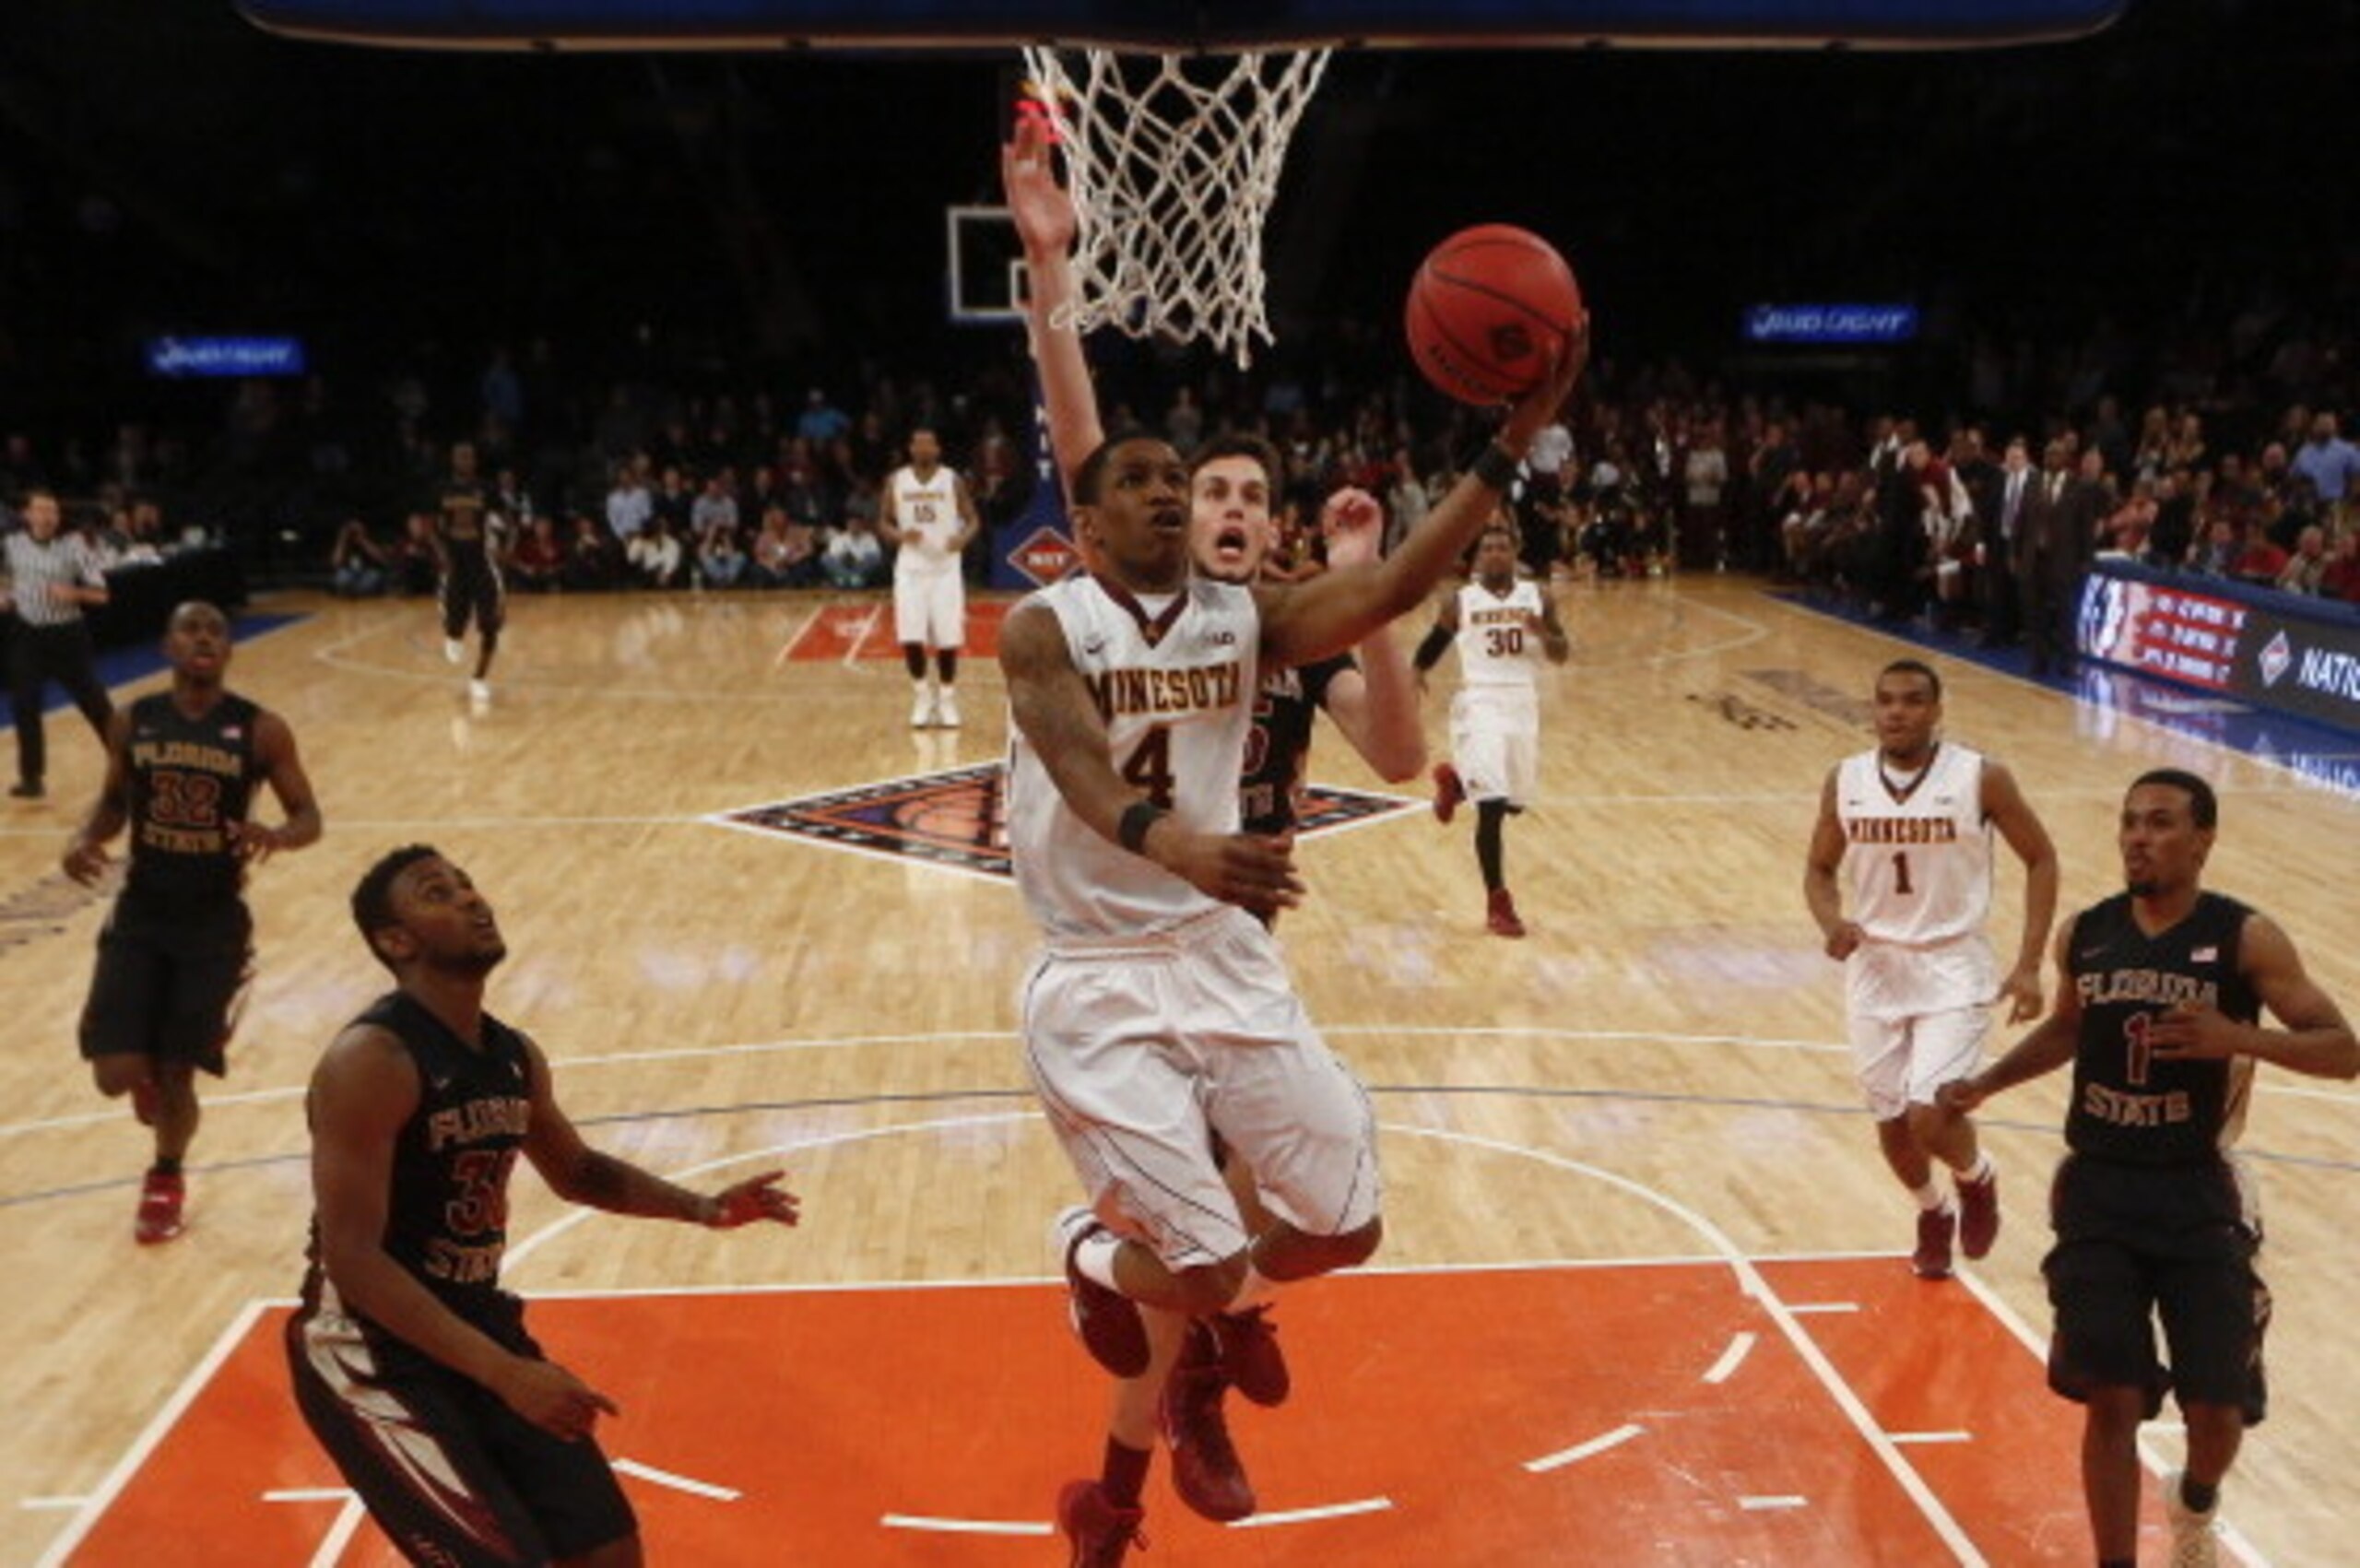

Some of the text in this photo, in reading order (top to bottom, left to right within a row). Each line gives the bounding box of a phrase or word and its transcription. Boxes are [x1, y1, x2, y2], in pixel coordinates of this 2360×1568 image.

[1485, 627, 1523, 658] 30
[1122, 725, 1176, 811] 4
[151, 770, 221, 826] 32
[1847, 817, 1957, 844] MINNESOTA
[1892, 850, 1915, 895] 1
[2076, 969, 2219, 1008] FLORIDA
[2123, 1011, 2152, 1087] 1
[2084, 1082, 2192, 1126] STATE
